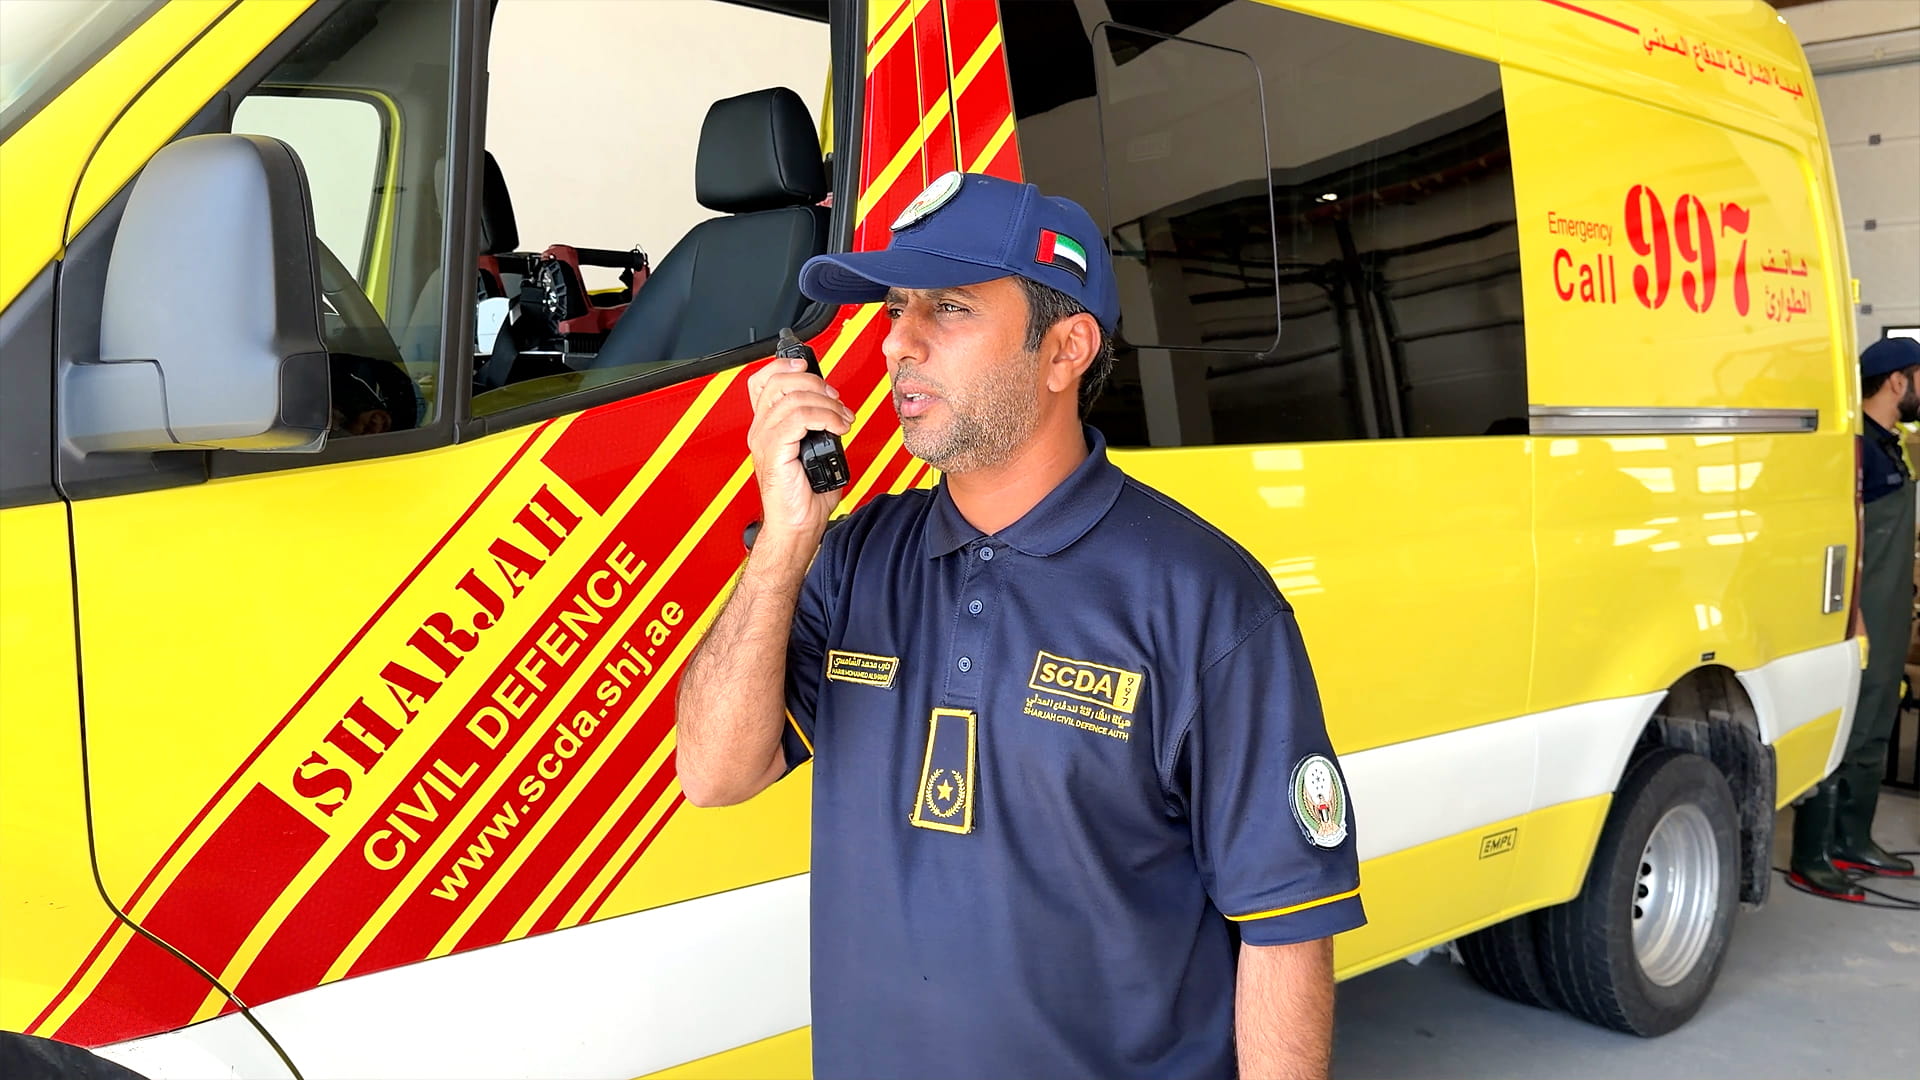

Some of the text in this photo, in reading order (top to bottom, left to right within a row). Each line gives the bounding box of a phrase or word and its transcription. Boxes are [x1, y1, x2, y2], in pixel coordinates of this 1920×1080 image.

[1643, 27, 1804, 101] هيئة الشارقة للدفاع المدني
[1548, 211, 1613, 246] Emergency
[1624, 184, 1750, 317] 997
[1761, 248, 1808, 277] هاتف
[1553, 248, 1616, 304] Call
[1765, 285, 1812, 323] الطوارئ
[292, 483, 583, 818] SHARJAH
[861, 660, 877, 668] محمد
[1040, 662, 1112, 699] SCDA
[1121, 677, 1135, 707] 997
[363, 541, 647, 871] CIVIL DEFENCE
[1024, 706, 1129, 743] SHARJAH CIVIL DEFENCE AUTH
[1080, 705, 1111, 723] الشارقة
[1112, 714, 1132, 729] هيئة
[430, 600, 684, 903] www.scda.shj.ae
[1484, 834, 1512, 853] EMPL
